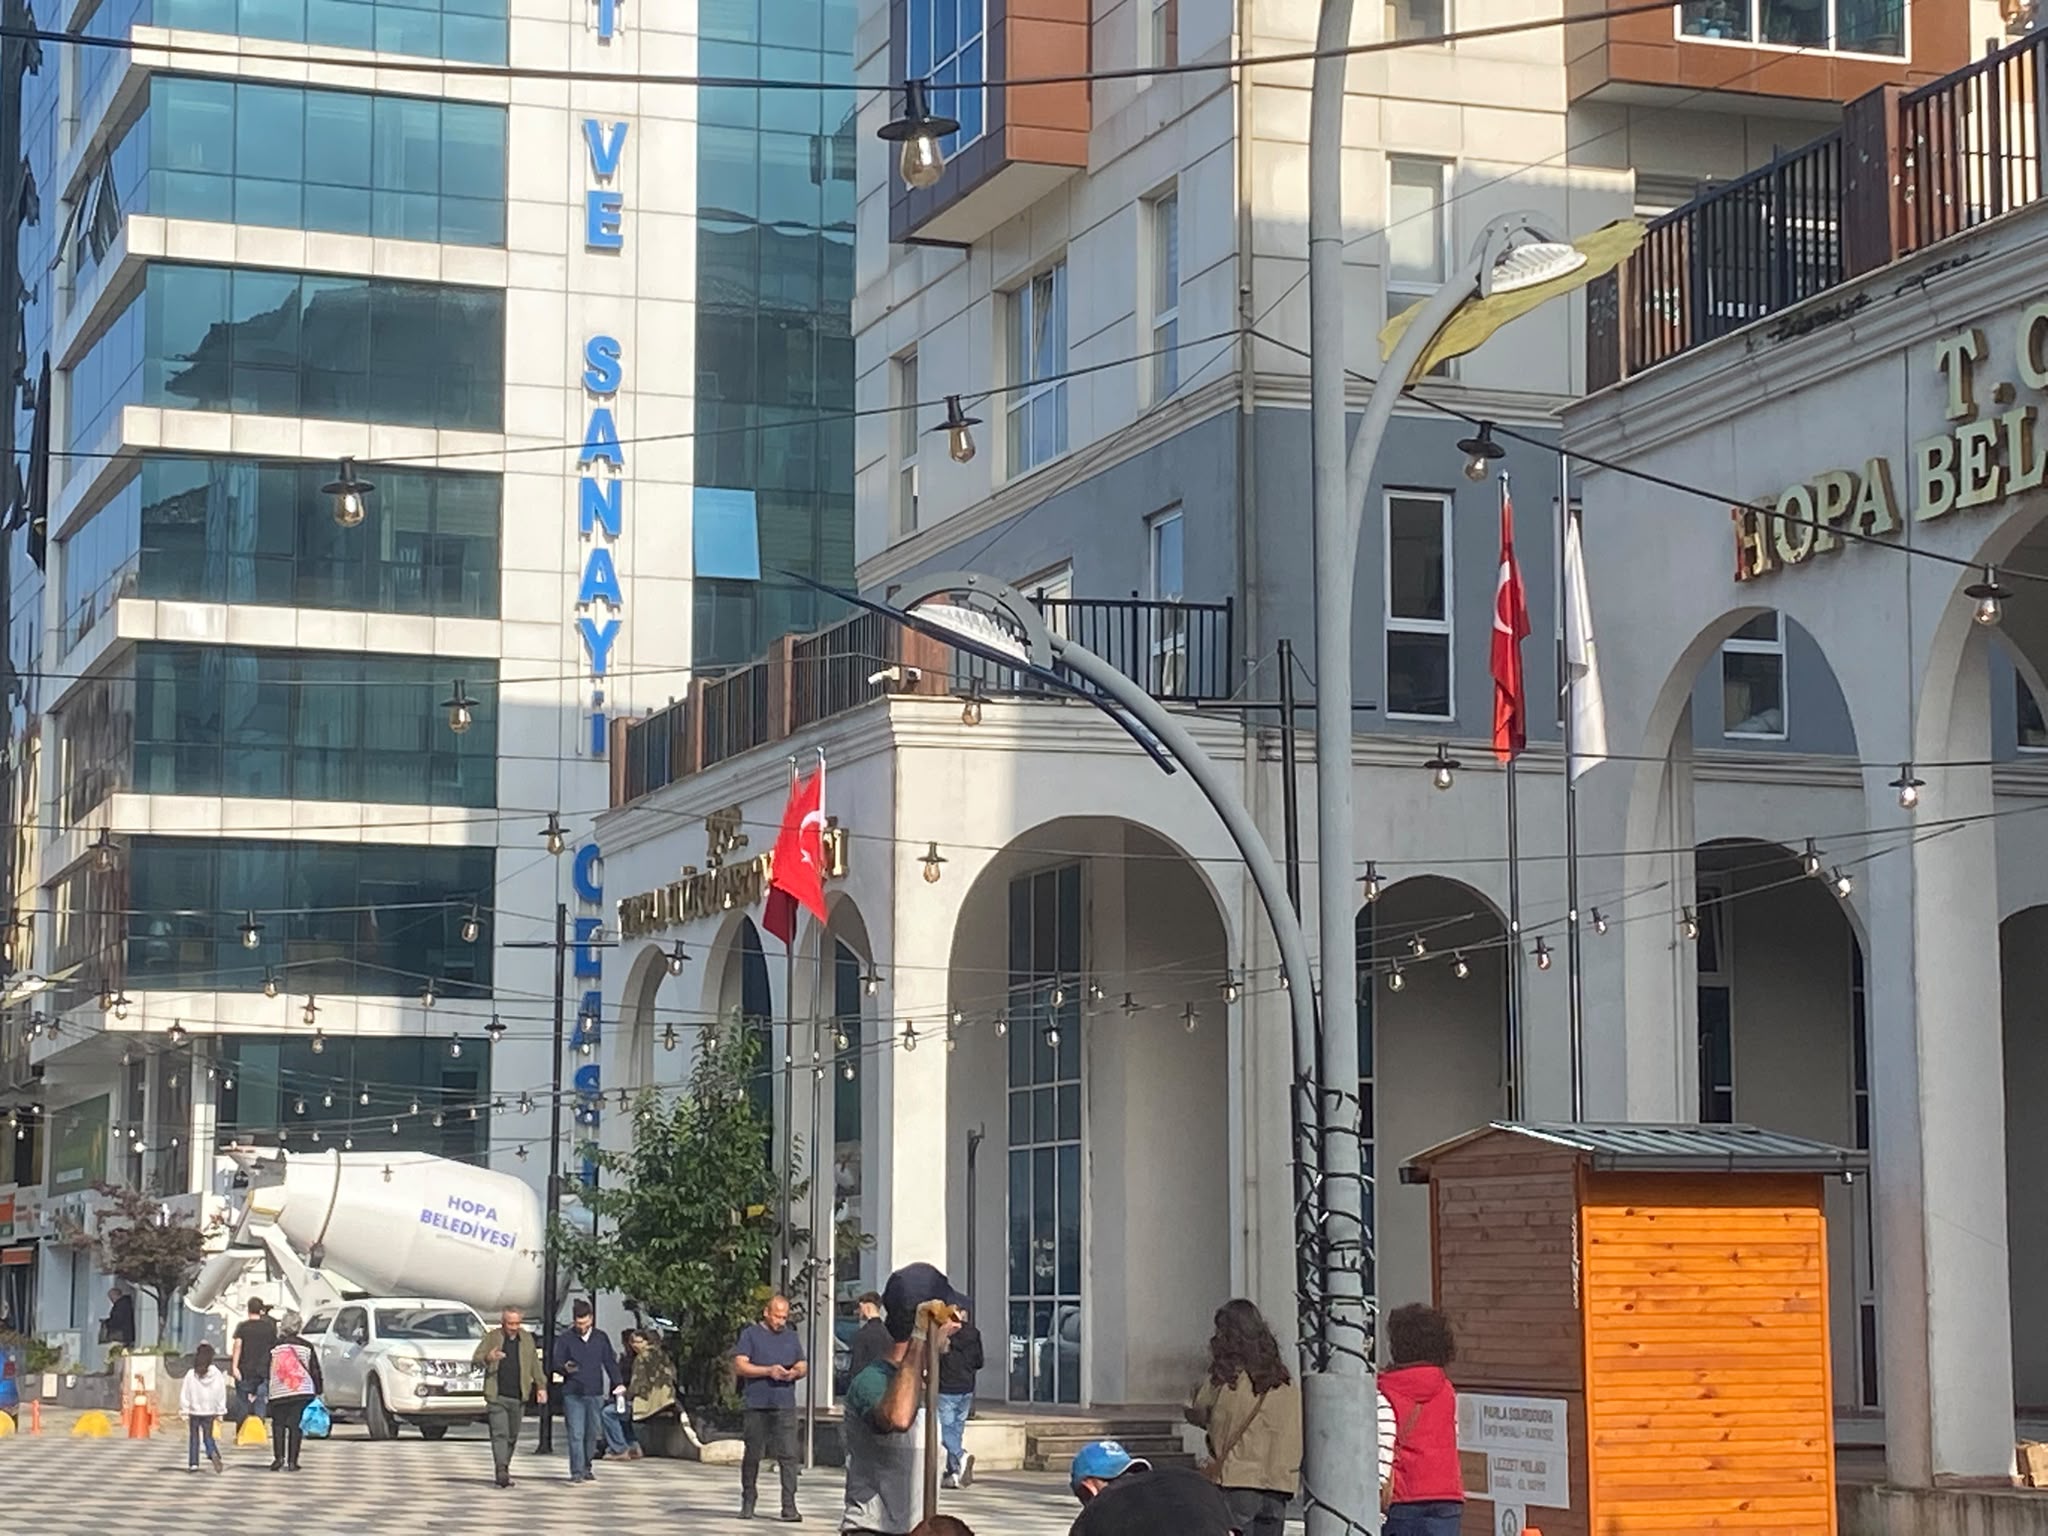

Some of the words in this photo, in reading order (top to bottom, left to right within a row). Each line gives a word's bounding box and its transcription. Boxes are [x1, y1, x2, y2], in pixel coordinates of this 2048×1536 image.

[582, 119, 628, 250] VE
[1731, 457, 1903, 584] HOPA
[420, 1209, 518, 1250] BELEDİYESİ
[447, 1195, 498, 1222] HOPA
